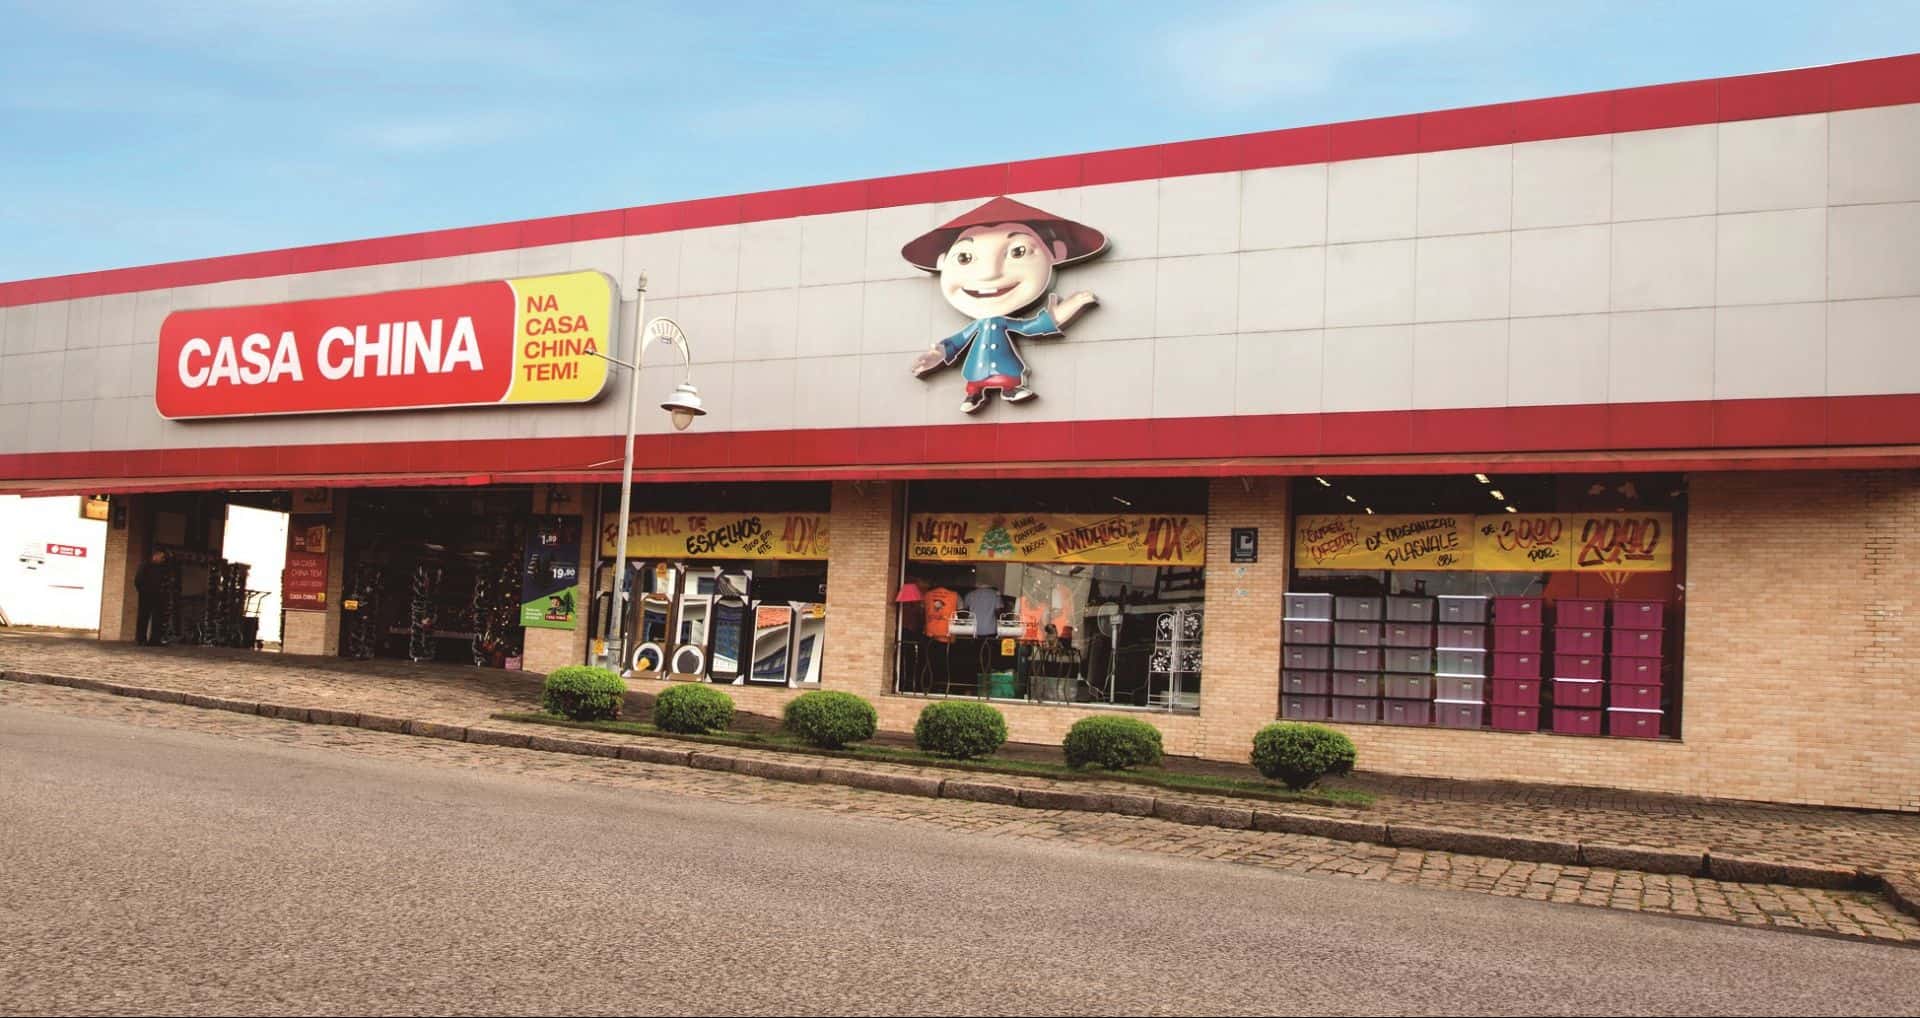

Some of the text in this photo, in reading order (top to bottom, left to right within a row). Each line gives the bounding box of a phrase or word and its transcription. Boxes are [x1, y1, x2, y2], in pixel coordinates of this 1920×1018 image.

[526, 294, 559, 313] NA
[525, 315, 589, 335] CASA
[178, 315, 484, 388] CASA CHINA
[524, 337, 598, 359] CHINA
[523, 362, 579, 382] TEM!
[686, 515, 762, 554] ESPELHOS
[780, 515, 820, 555] 10X
[915, 516, 975, 544] NATAL
[1055, 518, 1128, 555] NOVIDADES
[1143, 517, 1188, 561] 10X
[914, 545, 968, 557] CASA CHINA
[1385, 532, 1458, 566] PLASVALE
